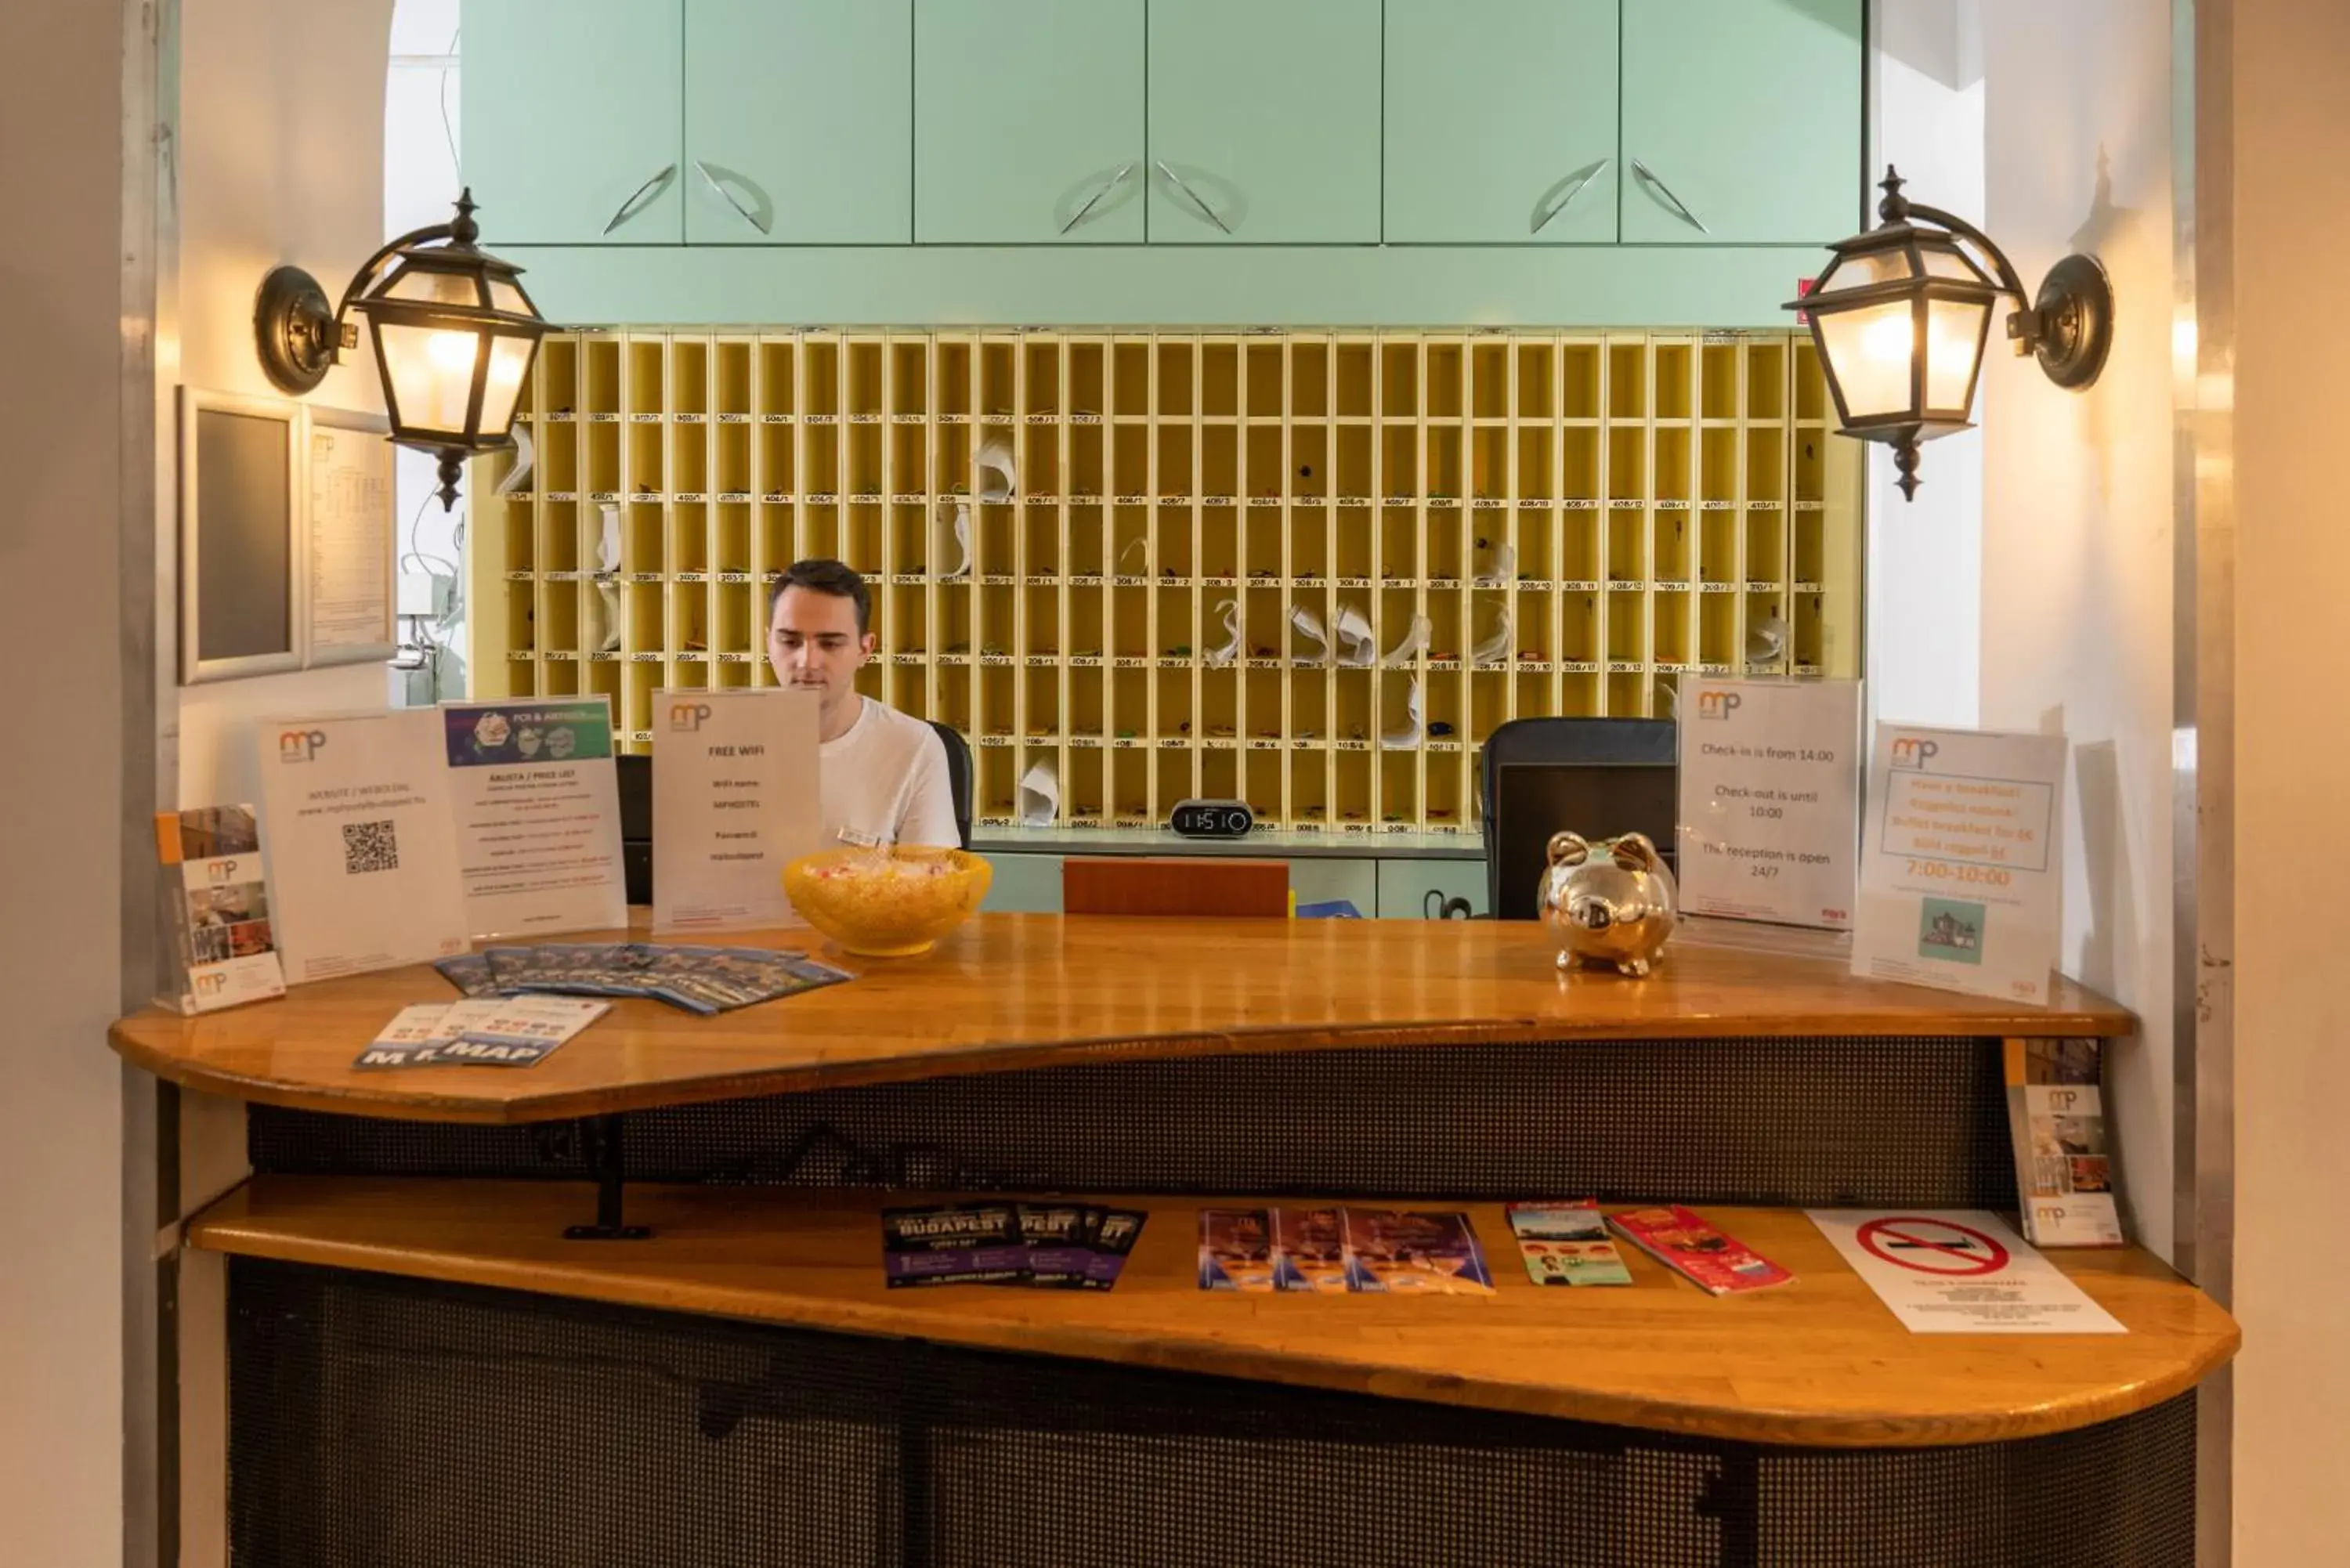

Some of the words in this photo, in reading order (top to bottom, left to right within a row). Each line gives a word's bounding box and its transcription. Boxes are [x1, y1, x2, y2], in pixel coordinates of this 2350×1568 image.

[708, 746, 736, 757] FREE
[739, 745, 765, 757] WIFI
[1701, 742, 1751, 757] Check-in
[1753, 747, 1763, 757] is
[1766, 746, 1796, 760] from
[1799, 749, 1835, 763] 14:00
[1714, 784, 1774, 801] Check-out
[1777, 787, 1788, 800] is
[1790, 789, 1819, 803] until
[1749, 805, 1784, 819] 10:00
[1726, 847, 1784, 863] reception
[1786, 851, 1796, 863] is
[1798, 853, 1831, 866] open
[1751, 864, 1780, 878] 24/7
[1905, 859, 2012, 887] 7:00-10:00
[443, 1042, 540, 1060] MAP
[899, 1219, 1006, 1235] BUDAPEST
